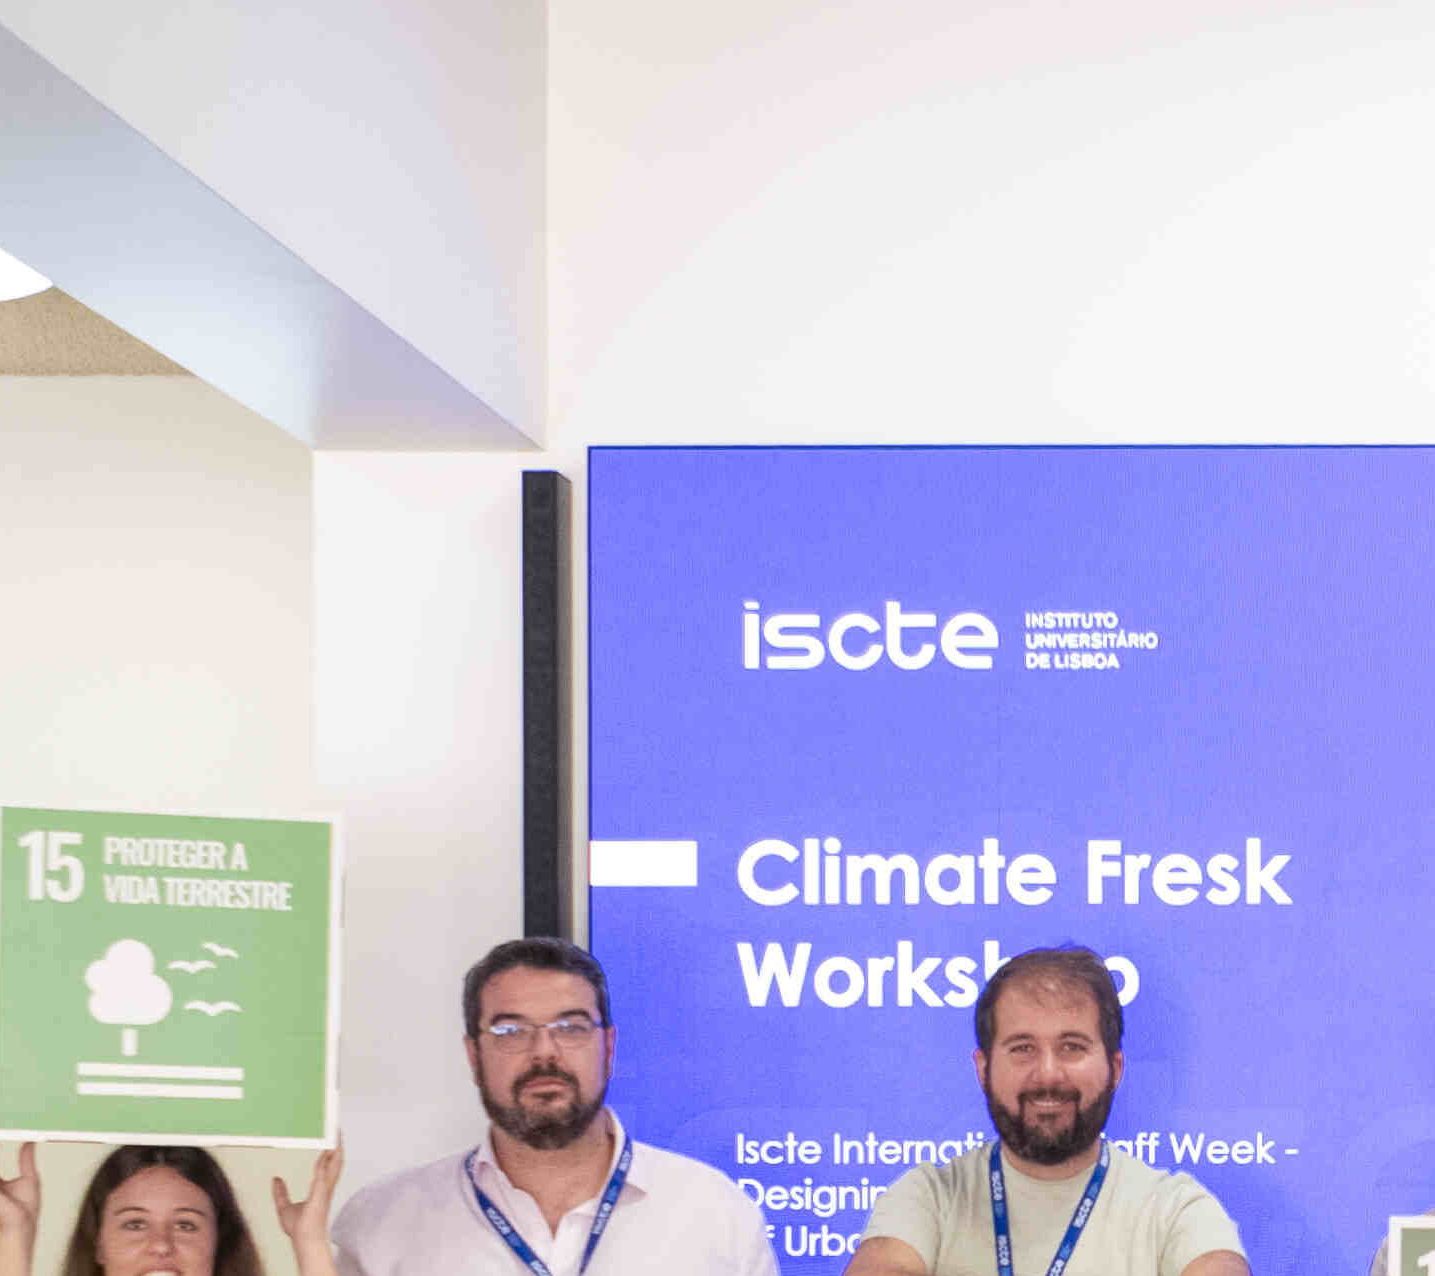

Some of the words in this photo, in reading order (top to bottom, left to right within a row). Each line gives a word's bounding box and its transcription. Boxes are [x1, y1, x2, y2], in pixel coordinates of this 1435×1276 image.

[743, 600, 1000, 671] iscte
[1025, 611, 1120, 630] INSTITUTO
[1025, 629, 1159, 650] UNIVERSITÁRIO
[1025, 653, 1051, 670] DE
[1054, 653, 1121, 670] LISBOA
[17, 829, 86, 903] 15
[103, 835, 227, 871] PROTEGER
[230, 841, 249, 872] A
[736, 838, 1058, 907] Climate
[1087, 838, 1294, 907] Fresk
[103, 873, 161, 905] VIDA
[163, 877, 293, 912] TERRESTRE
[735, 940, 1141, 1008] Workshp
[736, 1132, 822, 1165] Iscte
[1169, 1131, 1277, 1165] Week
